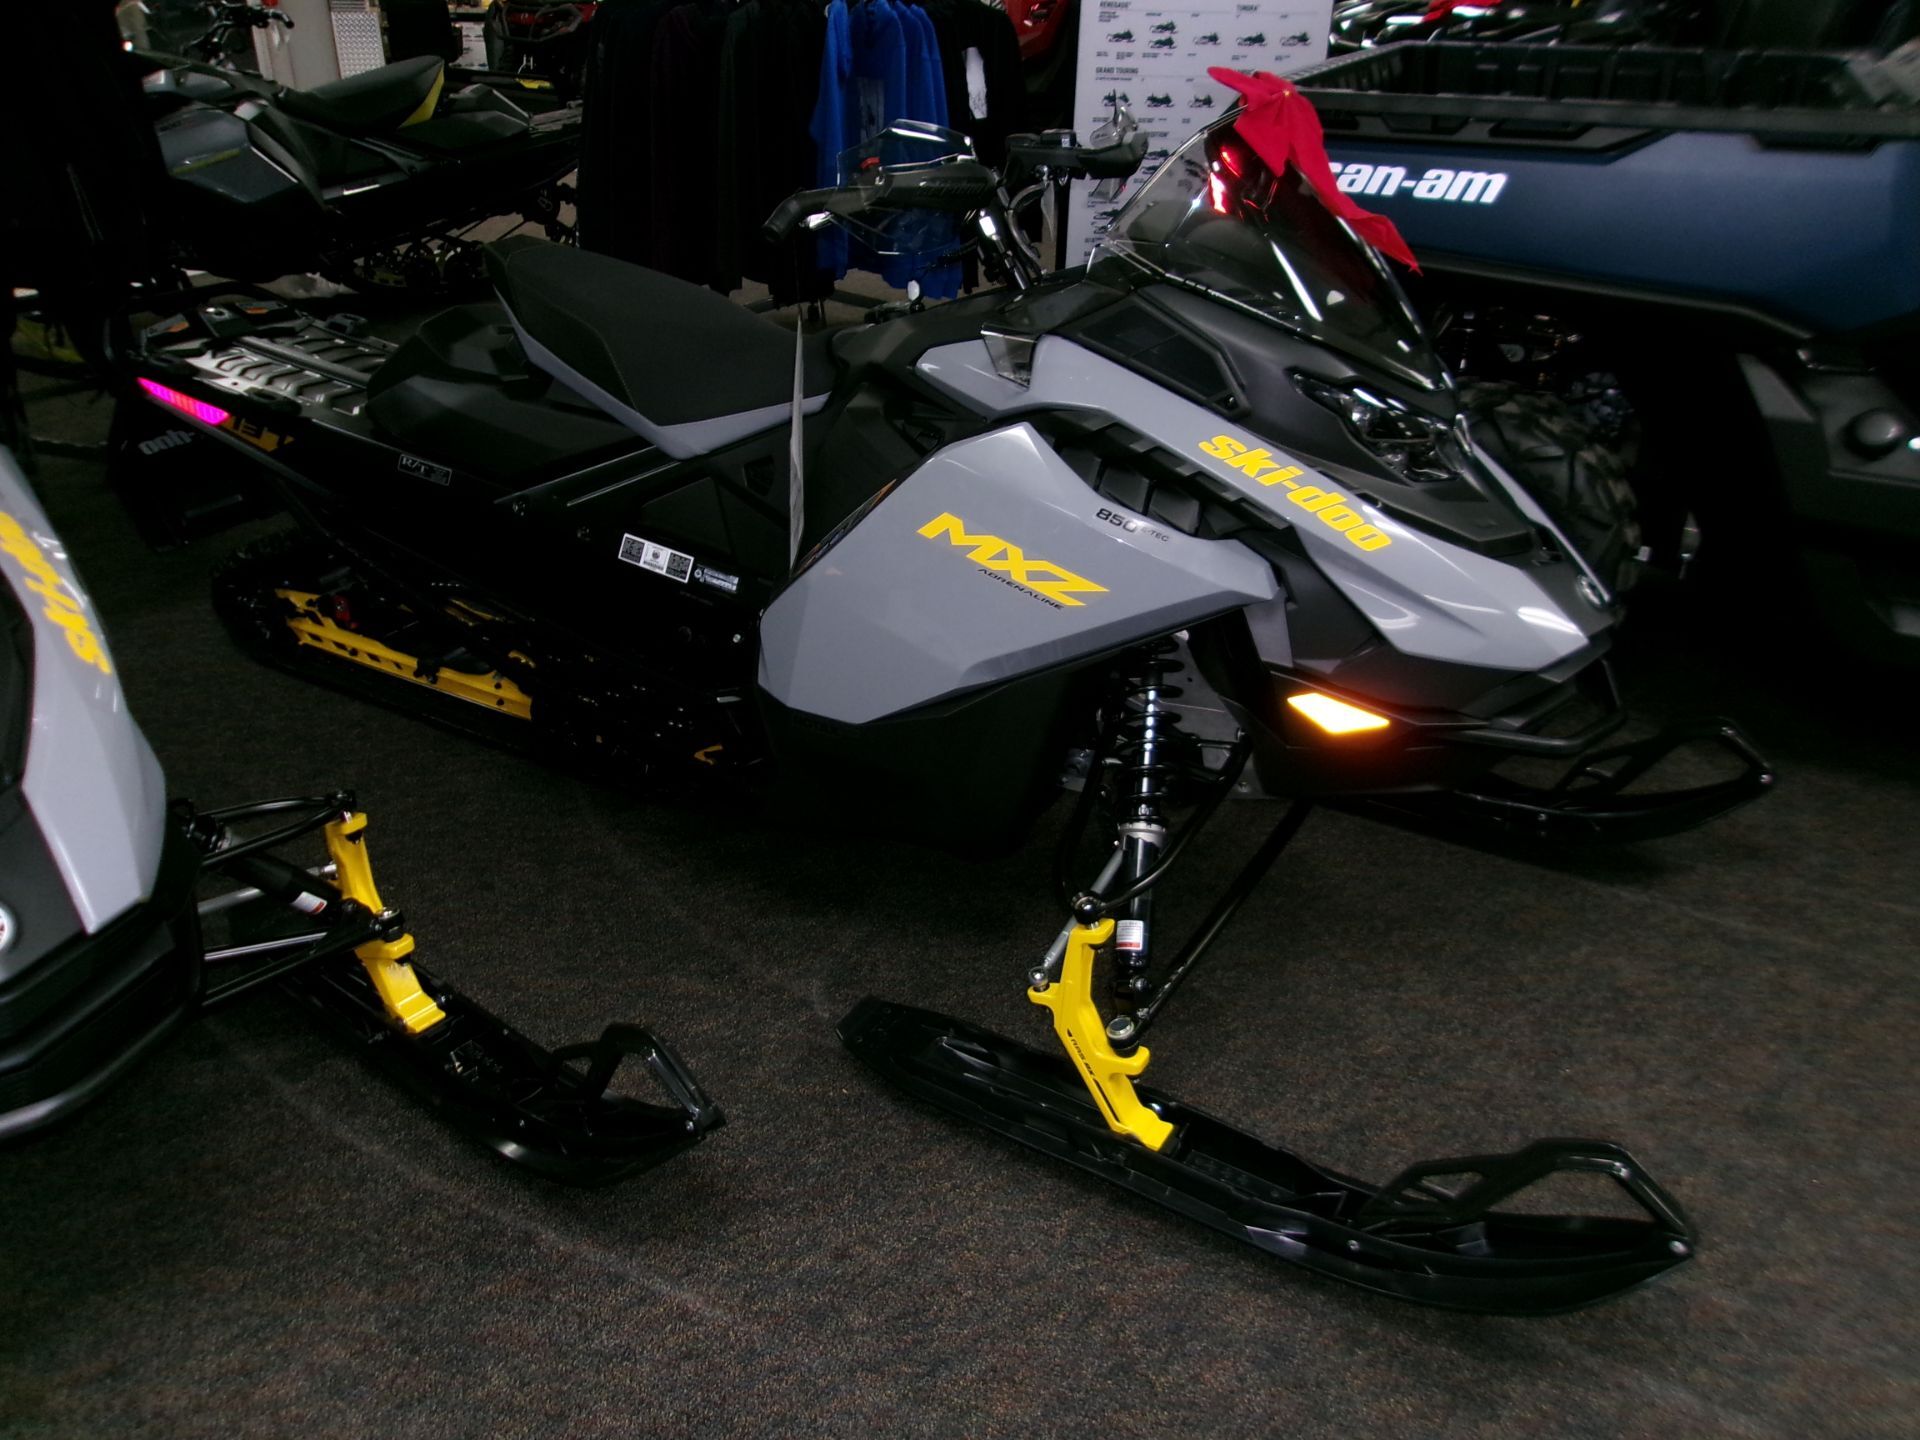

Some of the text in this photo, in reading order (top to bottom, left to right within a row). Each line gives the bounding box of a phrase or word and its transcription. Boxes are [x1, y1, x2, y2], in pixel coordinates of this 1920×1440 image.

[1095, 507, 1139, 534] 850
[1198, 434, 1393, 552] ski-doo
[915, 511, 1111, 607] MXZ
[976, 567, 1066, 611] ADRENALINE
